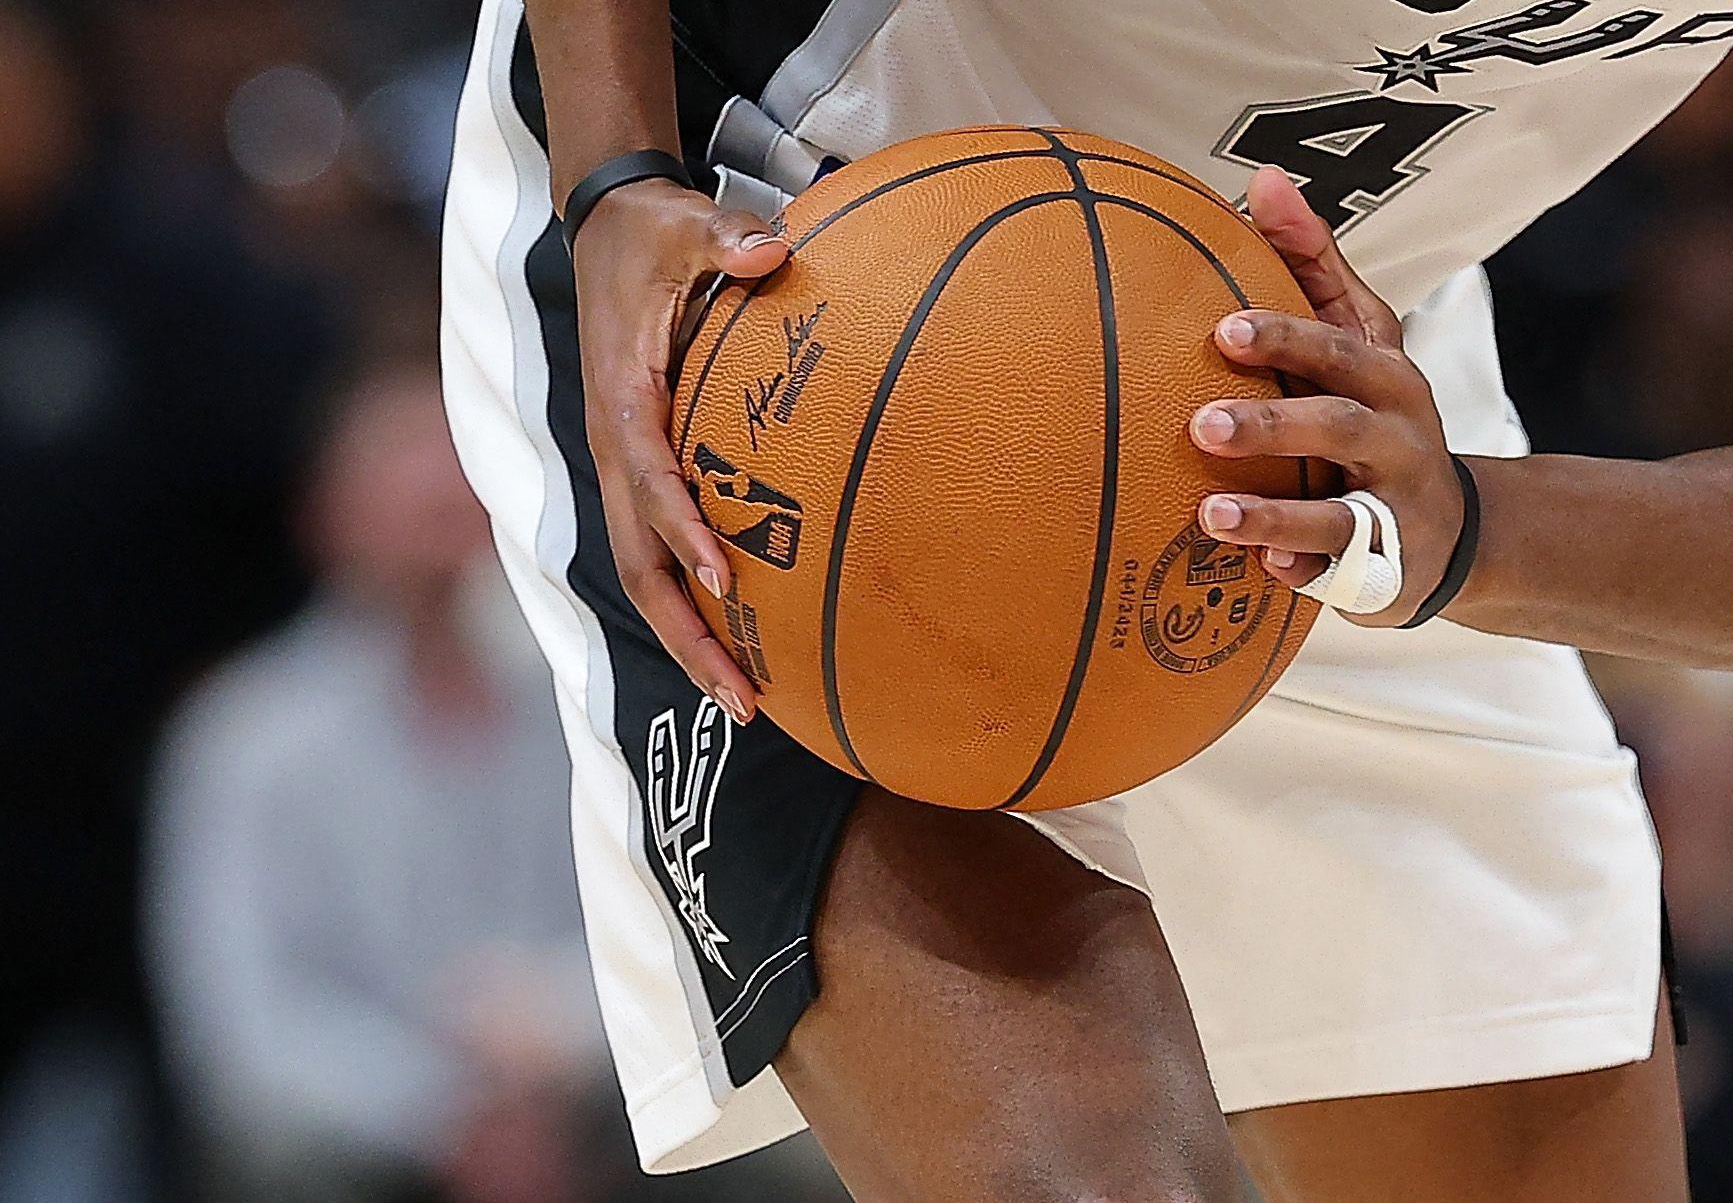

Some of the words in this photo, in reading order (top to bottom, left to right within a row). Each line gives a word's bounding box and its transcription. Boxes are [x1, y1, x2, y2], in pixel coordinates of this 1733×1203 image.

[1211, 90, 1494, 240] 4
[773, 341, 826, 425] COMMISSIONER
[767, 520, 793, 563] NBA
